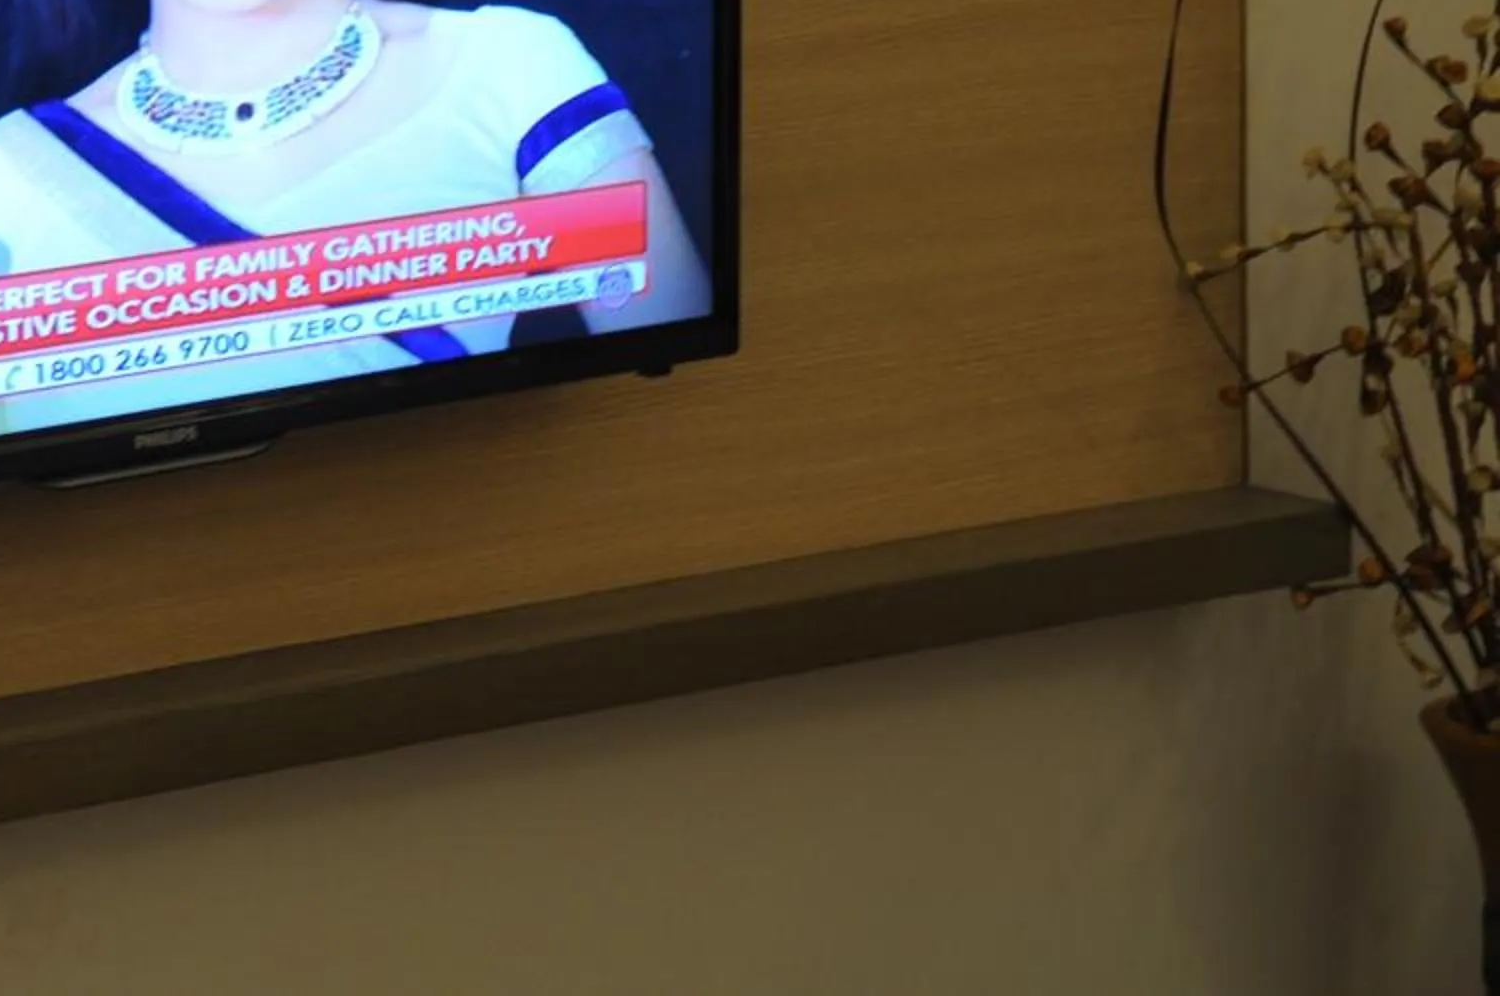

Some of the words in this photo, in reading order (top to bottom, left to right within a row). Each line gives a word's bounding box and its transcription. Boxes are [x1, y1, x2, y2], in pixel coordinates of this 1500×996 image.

[85, 280, 276, 330] OCCASION
[285, 275, 311, 299] &
[319, 254, 448, 292] DINNER
[455, 235, 554, 273] PARTY
[116, 256, 186, 293] FOR
[194, 241, 315, 283] FAMILY
[323, 211, 527, 262] GATHERING,
[34, 354, 106, 385] 1800
[115, 348, 167, 373] 266
[178, 330, 250, 359] 9700
[288, 313, 364, 343] ZERO
[374, 297, 443, 326] CALL
[452, 277, 586, 314] CHARGES
